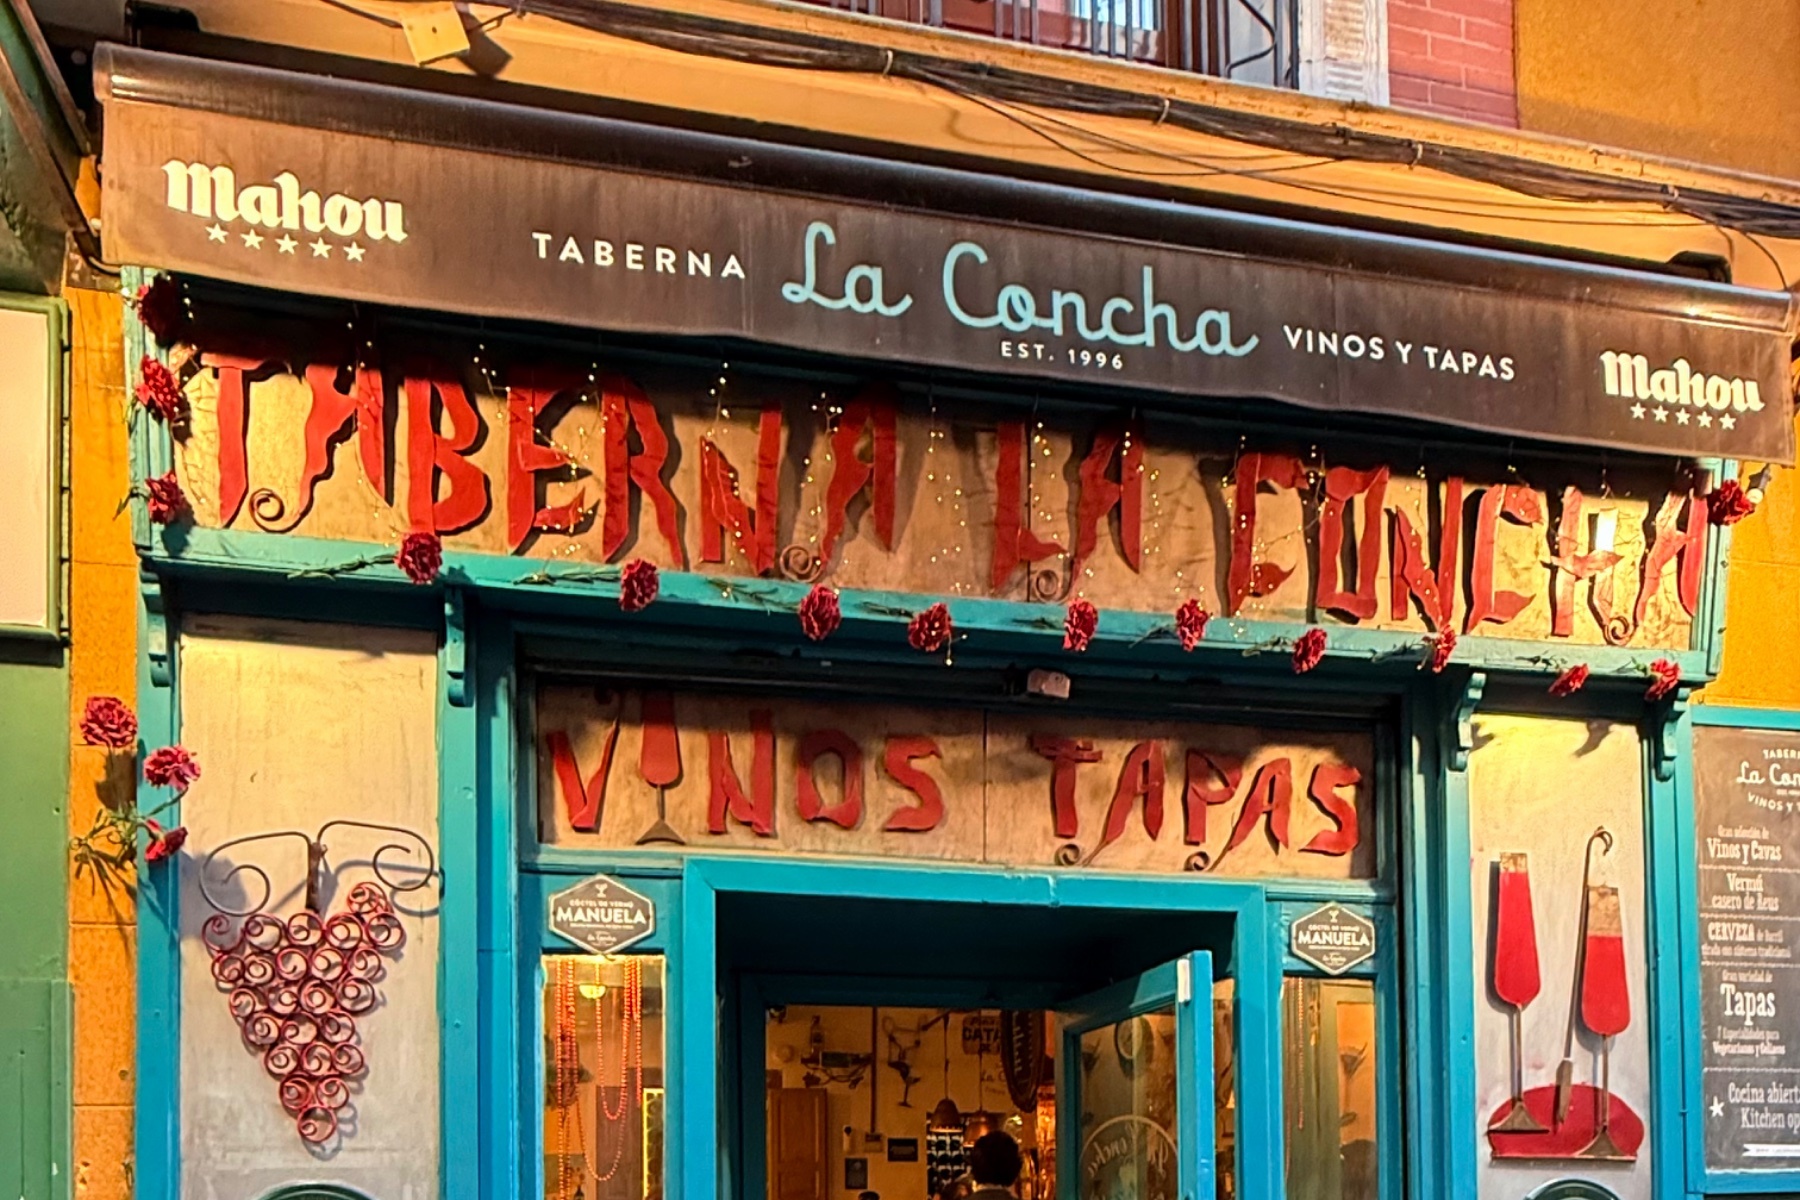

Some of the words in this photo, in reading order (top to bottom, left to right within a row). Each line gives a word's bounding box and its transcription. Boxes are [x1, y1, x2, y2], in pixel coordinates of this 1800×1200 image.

[162, 158, 409, 244] Mahou
[531, 230, 746, 281] TABERNA
[781, 221, 914, 318] La
[942, 241, 1259, 357] Concha
[1000, 341, 1054, 362] EST.
[1068, 348, 1124, 370] 1996
[1283, 324, 1385, 361] VINOS
[1395, 341, 1412, 365] Y
[1422, 346, 1515, 382] TAPAS
[1599, 349, 1766, 414] Mahou
[198, 350, 900, 582] TABERNA
[990, 412, 1145, 602] LA
[544, 686, 946, 846] VINOS
[1029, 734, 1363, 872] TAPAS
[1736, 761, 1766, 784] La
[1748, 791, 1783, 811] VINOS
[1706, 837, 1741, 859] Vinos
[1751, 840, 1782, 861] Cavas
[1726, 872, 1763, 893] Vermú
[1712, 895, 1742, 911] casero
[1743, 890, 1755, 911] de
[556, 906, 647, 924] MANUELA
[1298, 930, 1370, 946] MANUELA
[1708, 921, 1755, 942] CERVEZA
[1720, 983, 1776, 1026] Tapas
[1728, 1081, 1766, 1104] Cocina
[1740, 1106, 1785, 1128] Kitchen
